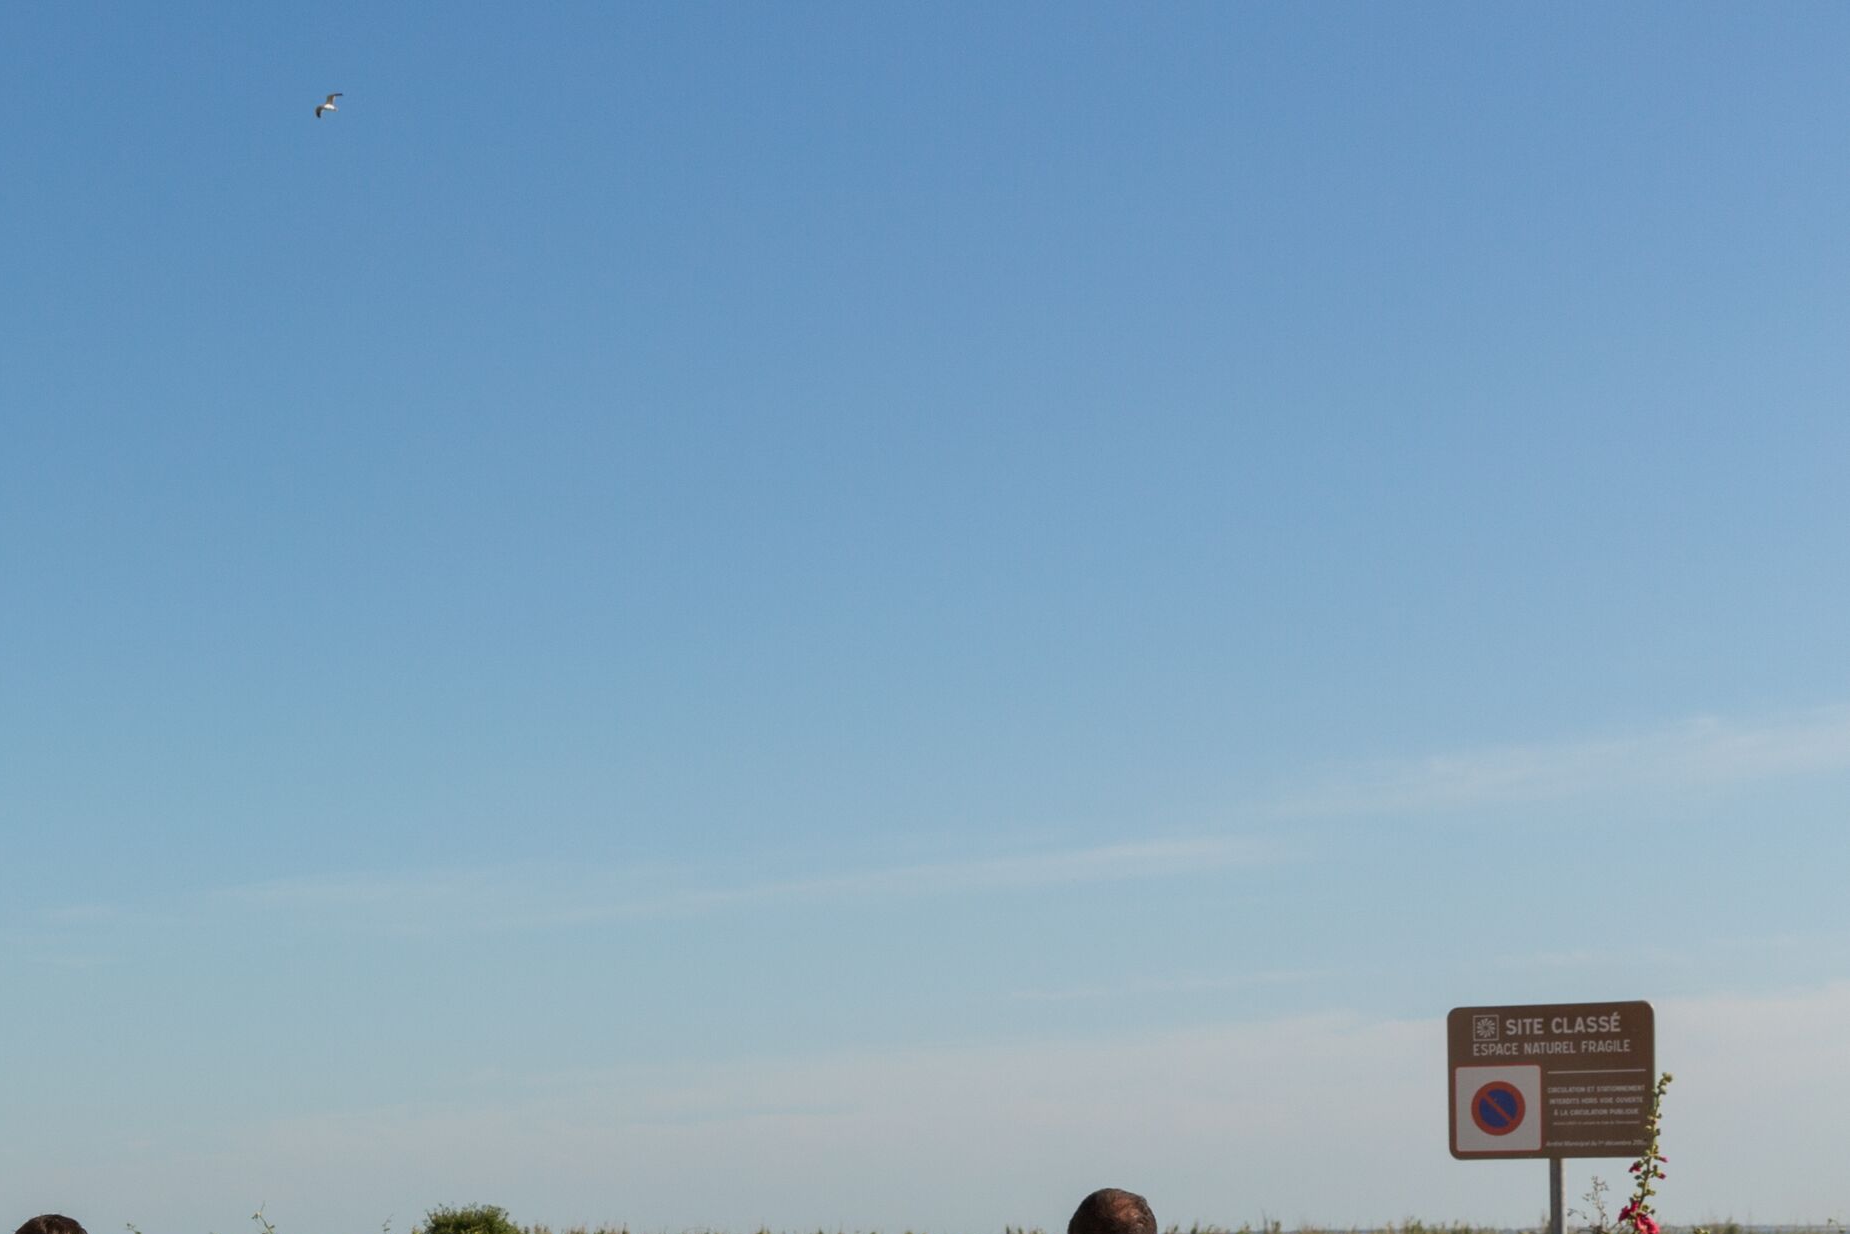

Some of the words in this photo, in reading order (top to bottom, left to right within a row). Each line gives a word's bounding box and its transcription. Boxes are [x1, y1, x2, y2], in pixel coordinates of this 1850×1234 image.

[1505, 1018, 1544, 1036] SITE
[1551, 1012, 1621, 1034] CLASSÉ
[1473, 1043, 1519, 1057] ESPACE
[1524, 1041, 1576, 1055] NATUREL
[1581, 1039, 1631, 1053] FRAGILE
[1547, 1086, 1586, 1094] CIRCULATION
[1596, 1084, 1646, 1093] STATIONNEMENT
[1614, 1096, 1644, 1104] OUVERTE
[1560, 1108, 1569, 1116] LA
[1569, 1108, 1608, 1116] CIRCULATION
[1609, 1107, 1639, 1115] PUBLIQUE
